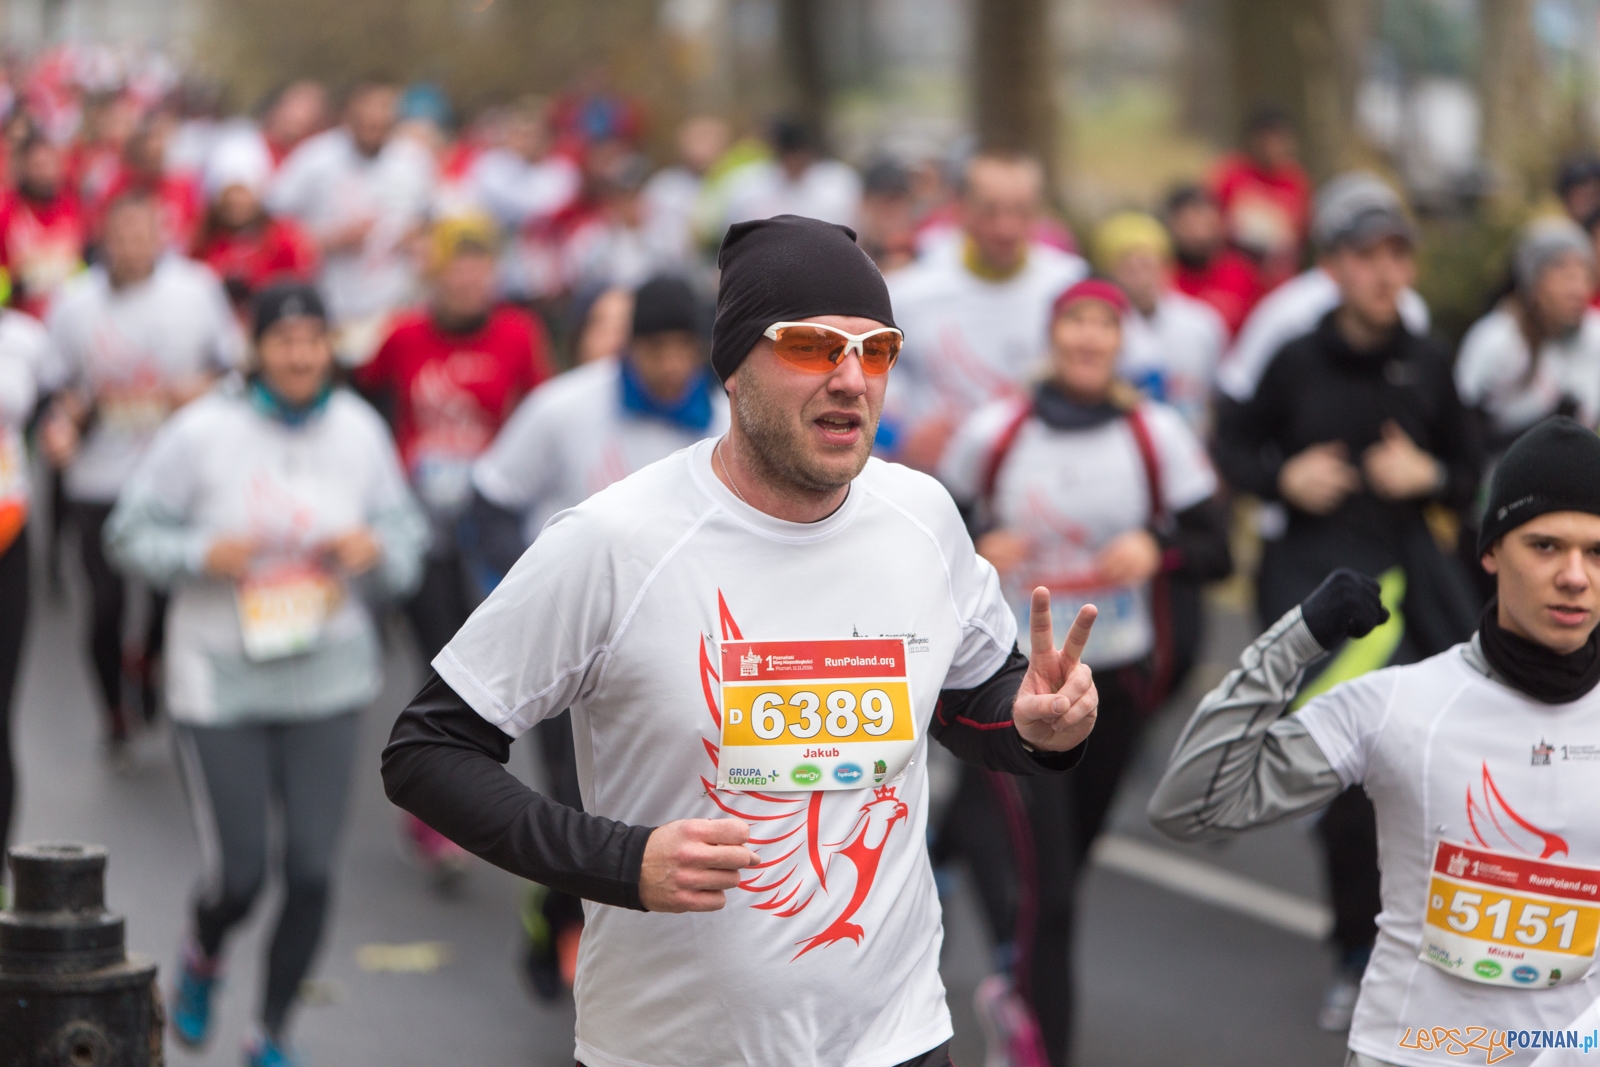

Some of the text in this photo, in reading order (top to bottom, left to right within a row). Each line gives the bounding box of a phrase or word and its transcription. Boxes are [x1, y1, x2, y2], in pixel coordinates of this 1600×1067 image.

[765, 655, 774, 671] 1
[824, 656, 895, 668] RunPoland.org
[728, 689, 895, 740] D 6389
[803, 748, 840, 758] Jakub
[729, 768, 762, 777] GRUPA
[795, 772, 819, 781] energy
[728, 777, 767, 785] LUXMED
[1529, 873, 1598, 896] RunPoland.org
[1431, 889, 1579, 950] D 5151
